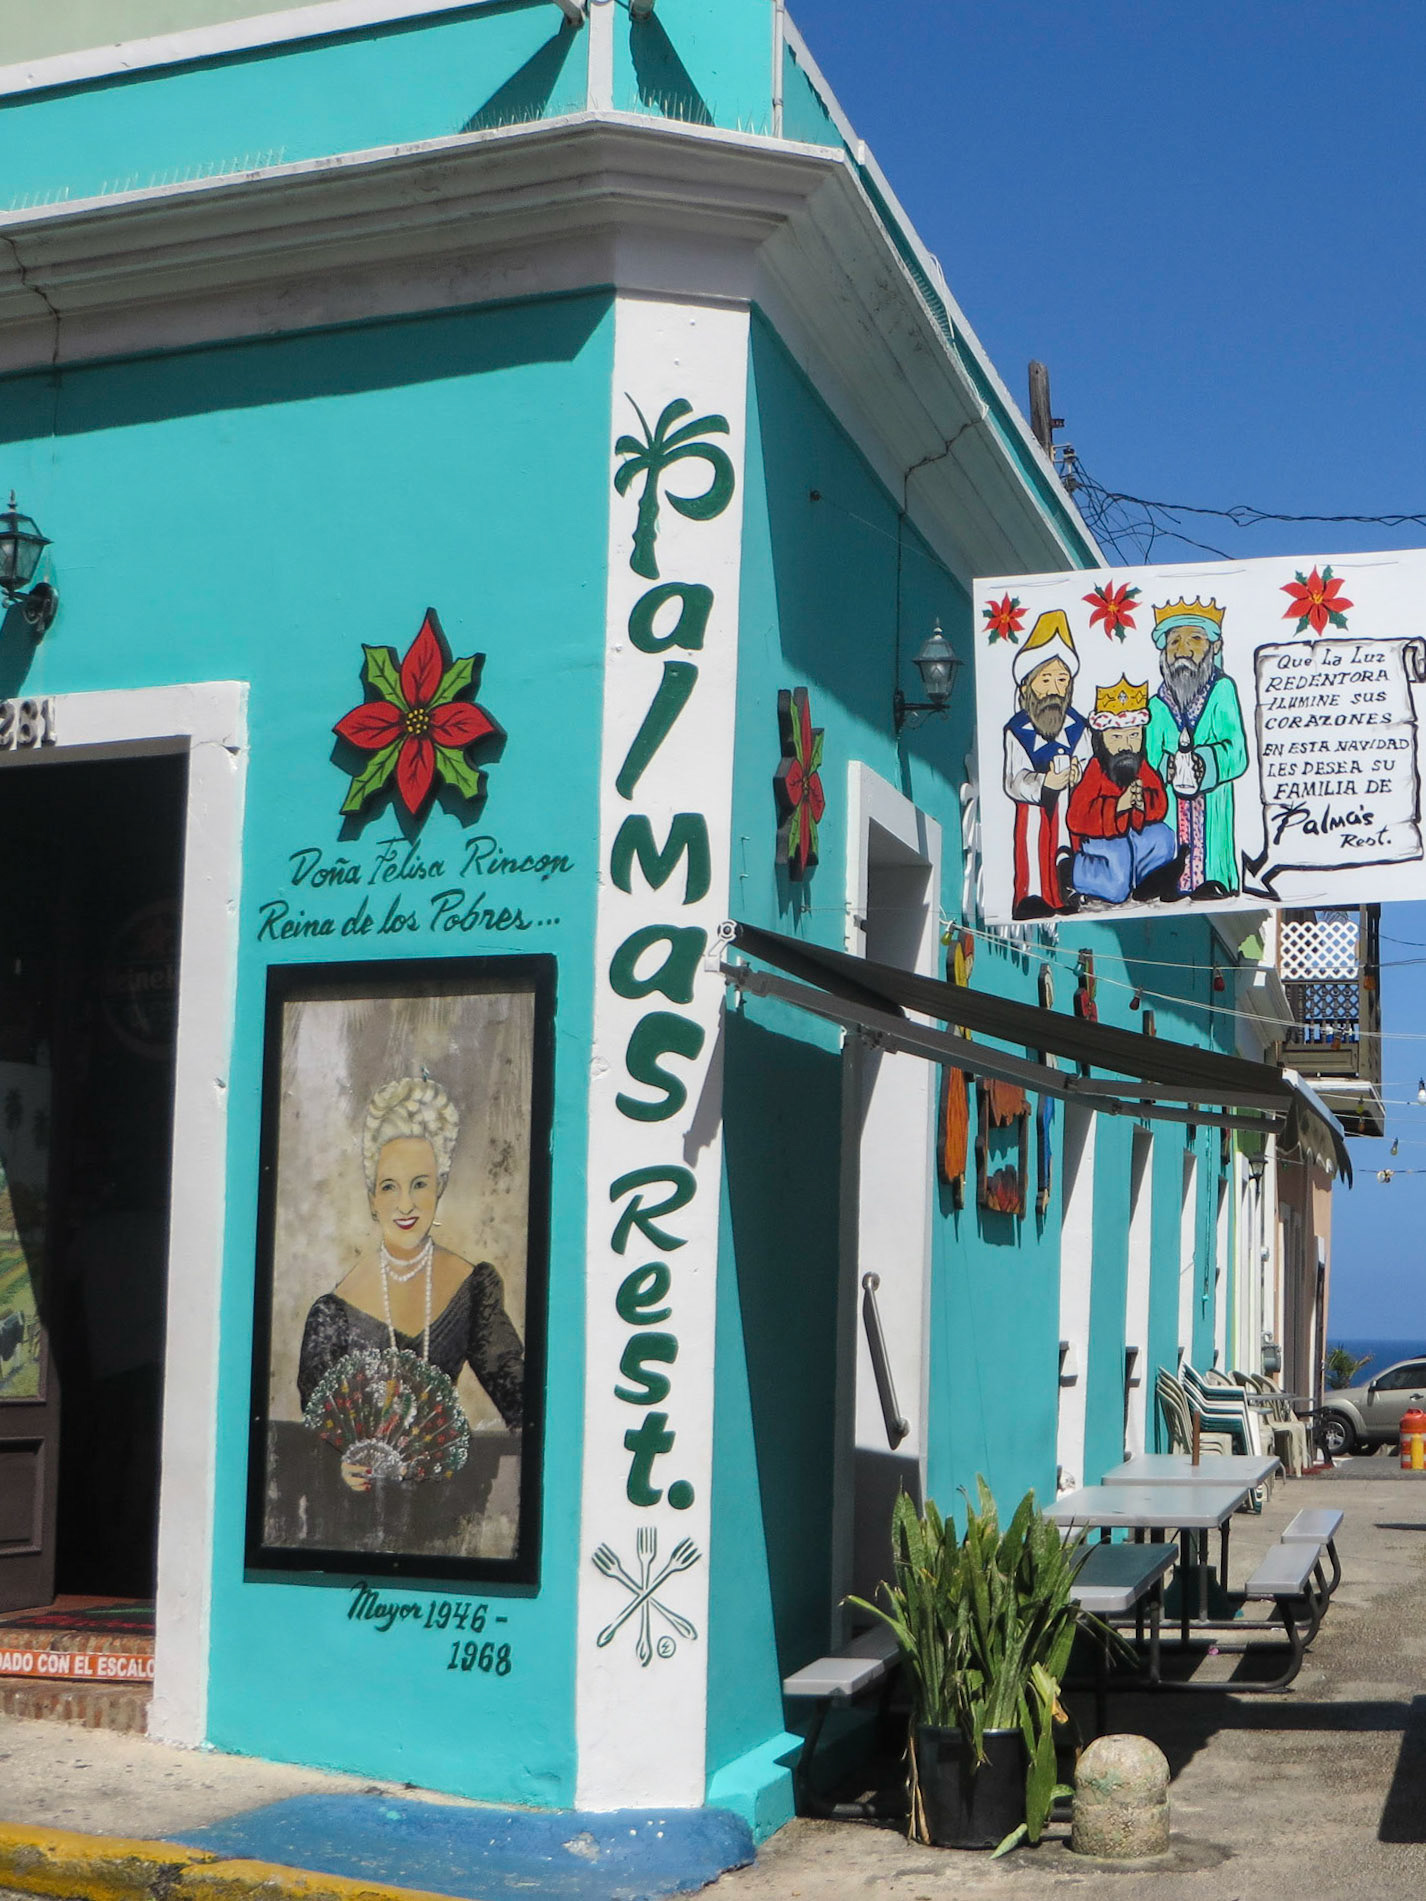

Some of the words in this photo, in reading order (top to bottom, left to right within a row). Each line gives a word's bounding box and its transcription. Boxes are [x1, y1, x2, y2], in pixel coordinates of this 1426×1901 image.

[1277, 654, 1313, 670] Que
[1321, 648, 1343, 667] La
[1350, 646, 1387, 665] Luz
[1264, 669, 1391, 693] REDENTORA
[1268, 693, 1341, 711] ILUMINE
[1264, 712, 1392, 731] CORAZONES
[1263, 743, 1285, 757] EN
[1288, 740, 1331, 755] ESTA
[1334, 738, 1410, 753] NAVIDAD
[1267, 762, 1299, 778] LES
[1301, 759, 1363, 776] DESEA
[1371, 759, 1396, 773] SU
[1273, 780, 1358, 800] FAMILIA
[1364, 778, 1393, 795] DE
[1340, 824, 1392, 849] Rest.
[289, 847, 361, 888] Doña
[367, 837, 445, 886] Felisa
[257, 900, 336, 942] Reina
[341, 895, 374, 938] de
[377, 893, 421, 934] los
[608, 1164, 698, 1511] Rest.
[346, 1580, 423, 1633] Mayor
[0, 1651, 34, 1673] ADO
[37, 1653, 70, 1674] CON
[73, 1655, 93, 1676] EL
[447, 1640, 513, 1677] 1968
